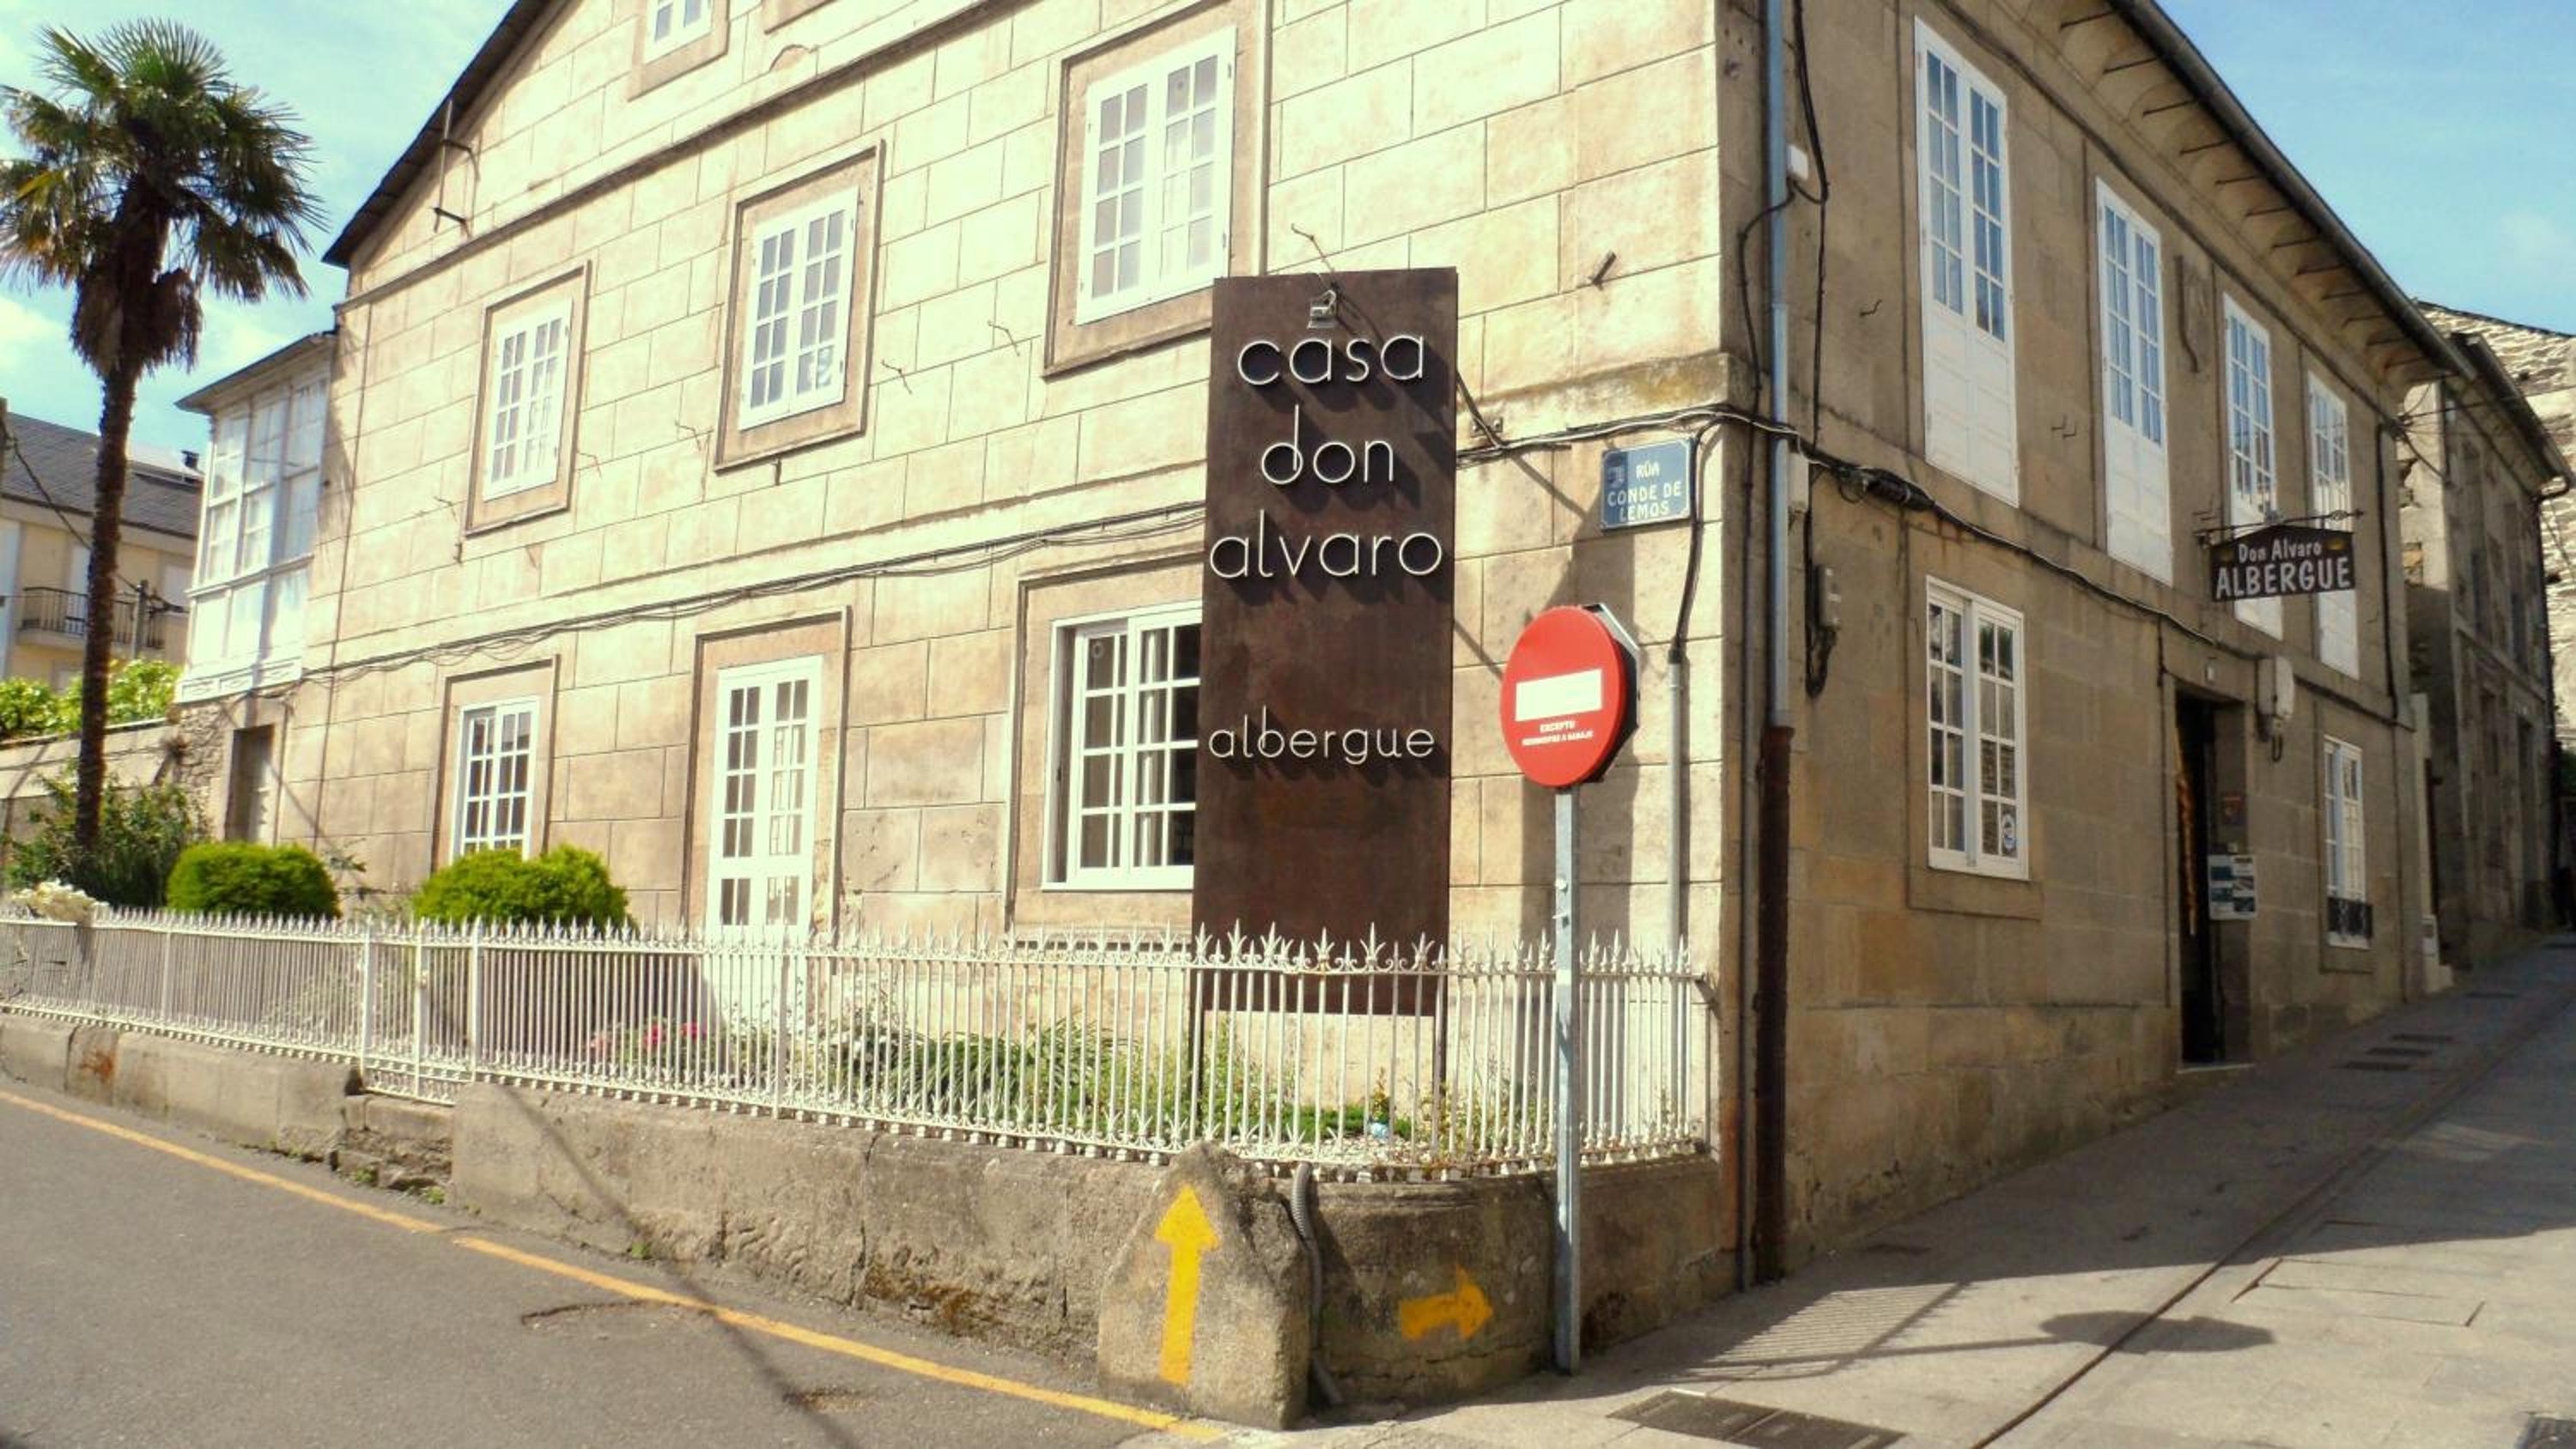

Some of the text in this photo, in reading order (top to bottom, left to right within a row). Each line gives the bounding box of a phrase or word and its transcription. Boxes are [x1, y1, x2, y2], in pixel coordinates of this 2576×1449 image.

[1237, 336, 1425, 385] casa
[1261, 405, 1394, 486] don
[1607, 482, 1682, 506] CONDE DE
[1619, 500, 1669, 522] LEMOS
[1210, 509, 1443, 578] alvaro
[2239, 537, 2323, 563] Don Alvaro
[2216, 557, 2351, 599] ALBERGUE
[1208, 705, 1436, 765] albergue
